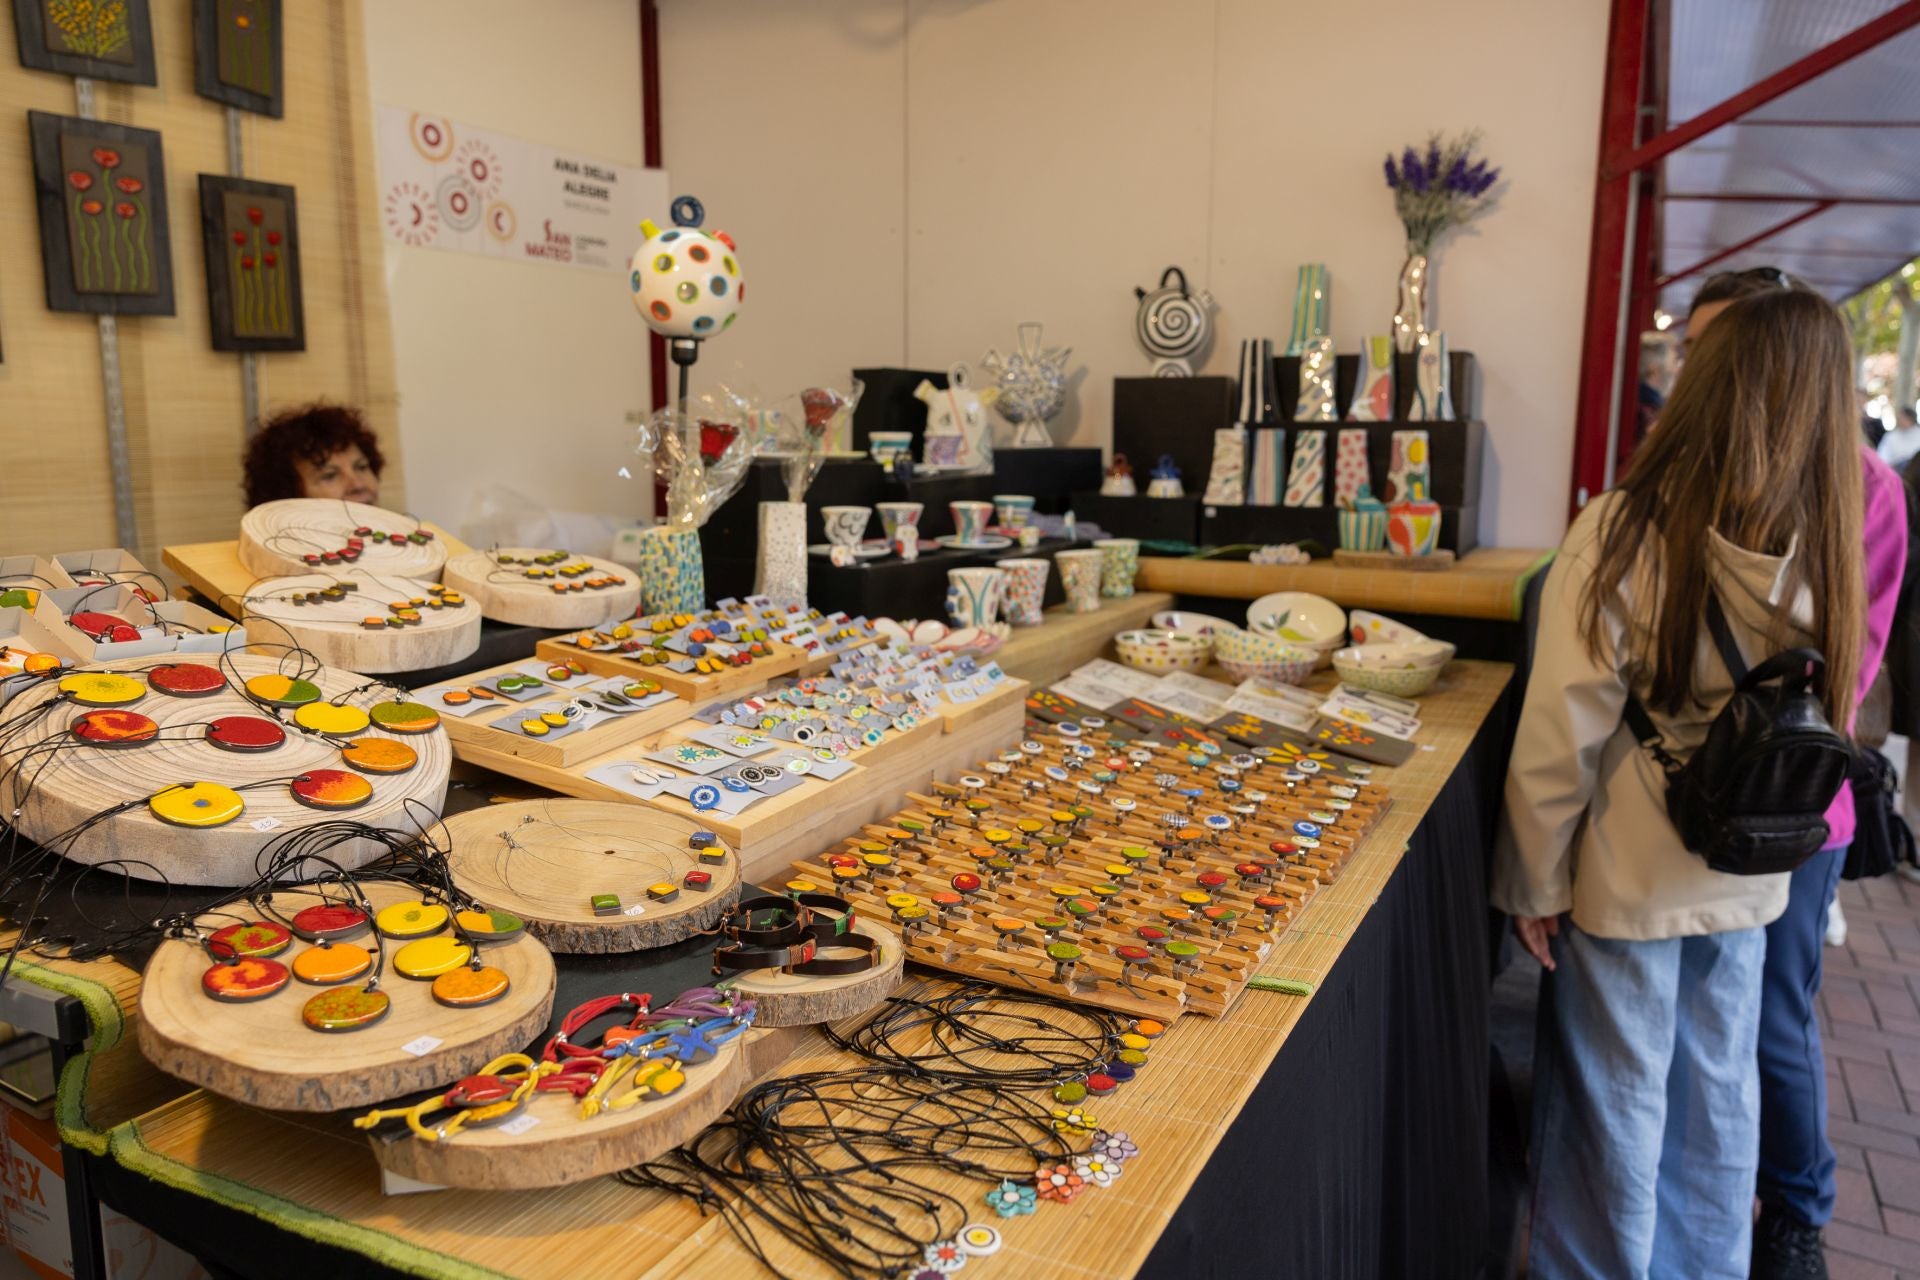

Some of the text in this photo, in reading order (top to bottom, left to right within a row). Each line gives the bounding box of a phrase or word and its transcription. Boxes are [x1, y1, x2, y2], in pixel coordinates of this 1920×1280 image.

[554, 159, 616, 182] ANA DELIA
[564, 181, 608, 200] ALEGRE
[526, 242, 572, 262] MATEO
